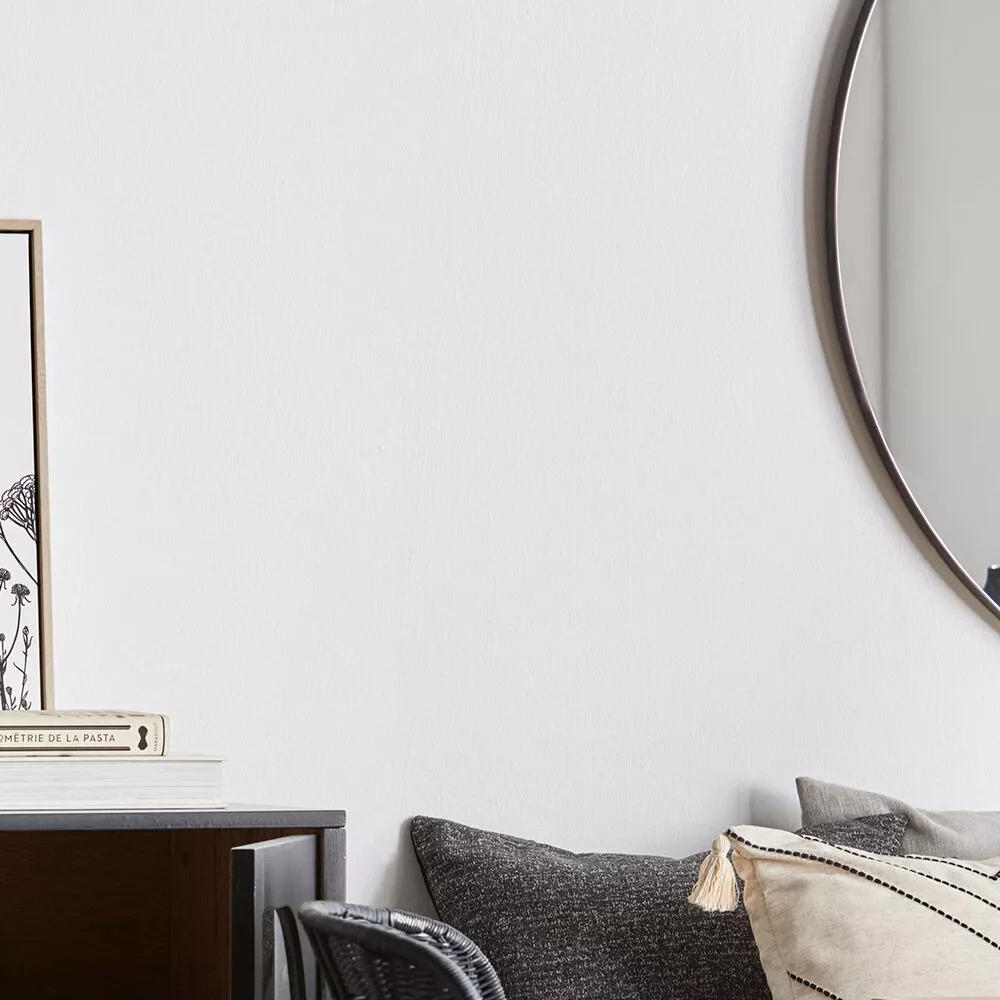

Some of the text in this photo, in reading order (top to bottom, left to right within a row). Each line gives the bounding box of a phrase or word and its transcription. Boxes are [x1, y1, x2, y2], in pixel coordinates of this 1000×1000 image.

[48, 733, 61, 742] DE
[66, 733, 79, 742] LA
[83, 733, 116, 743] PASTA
